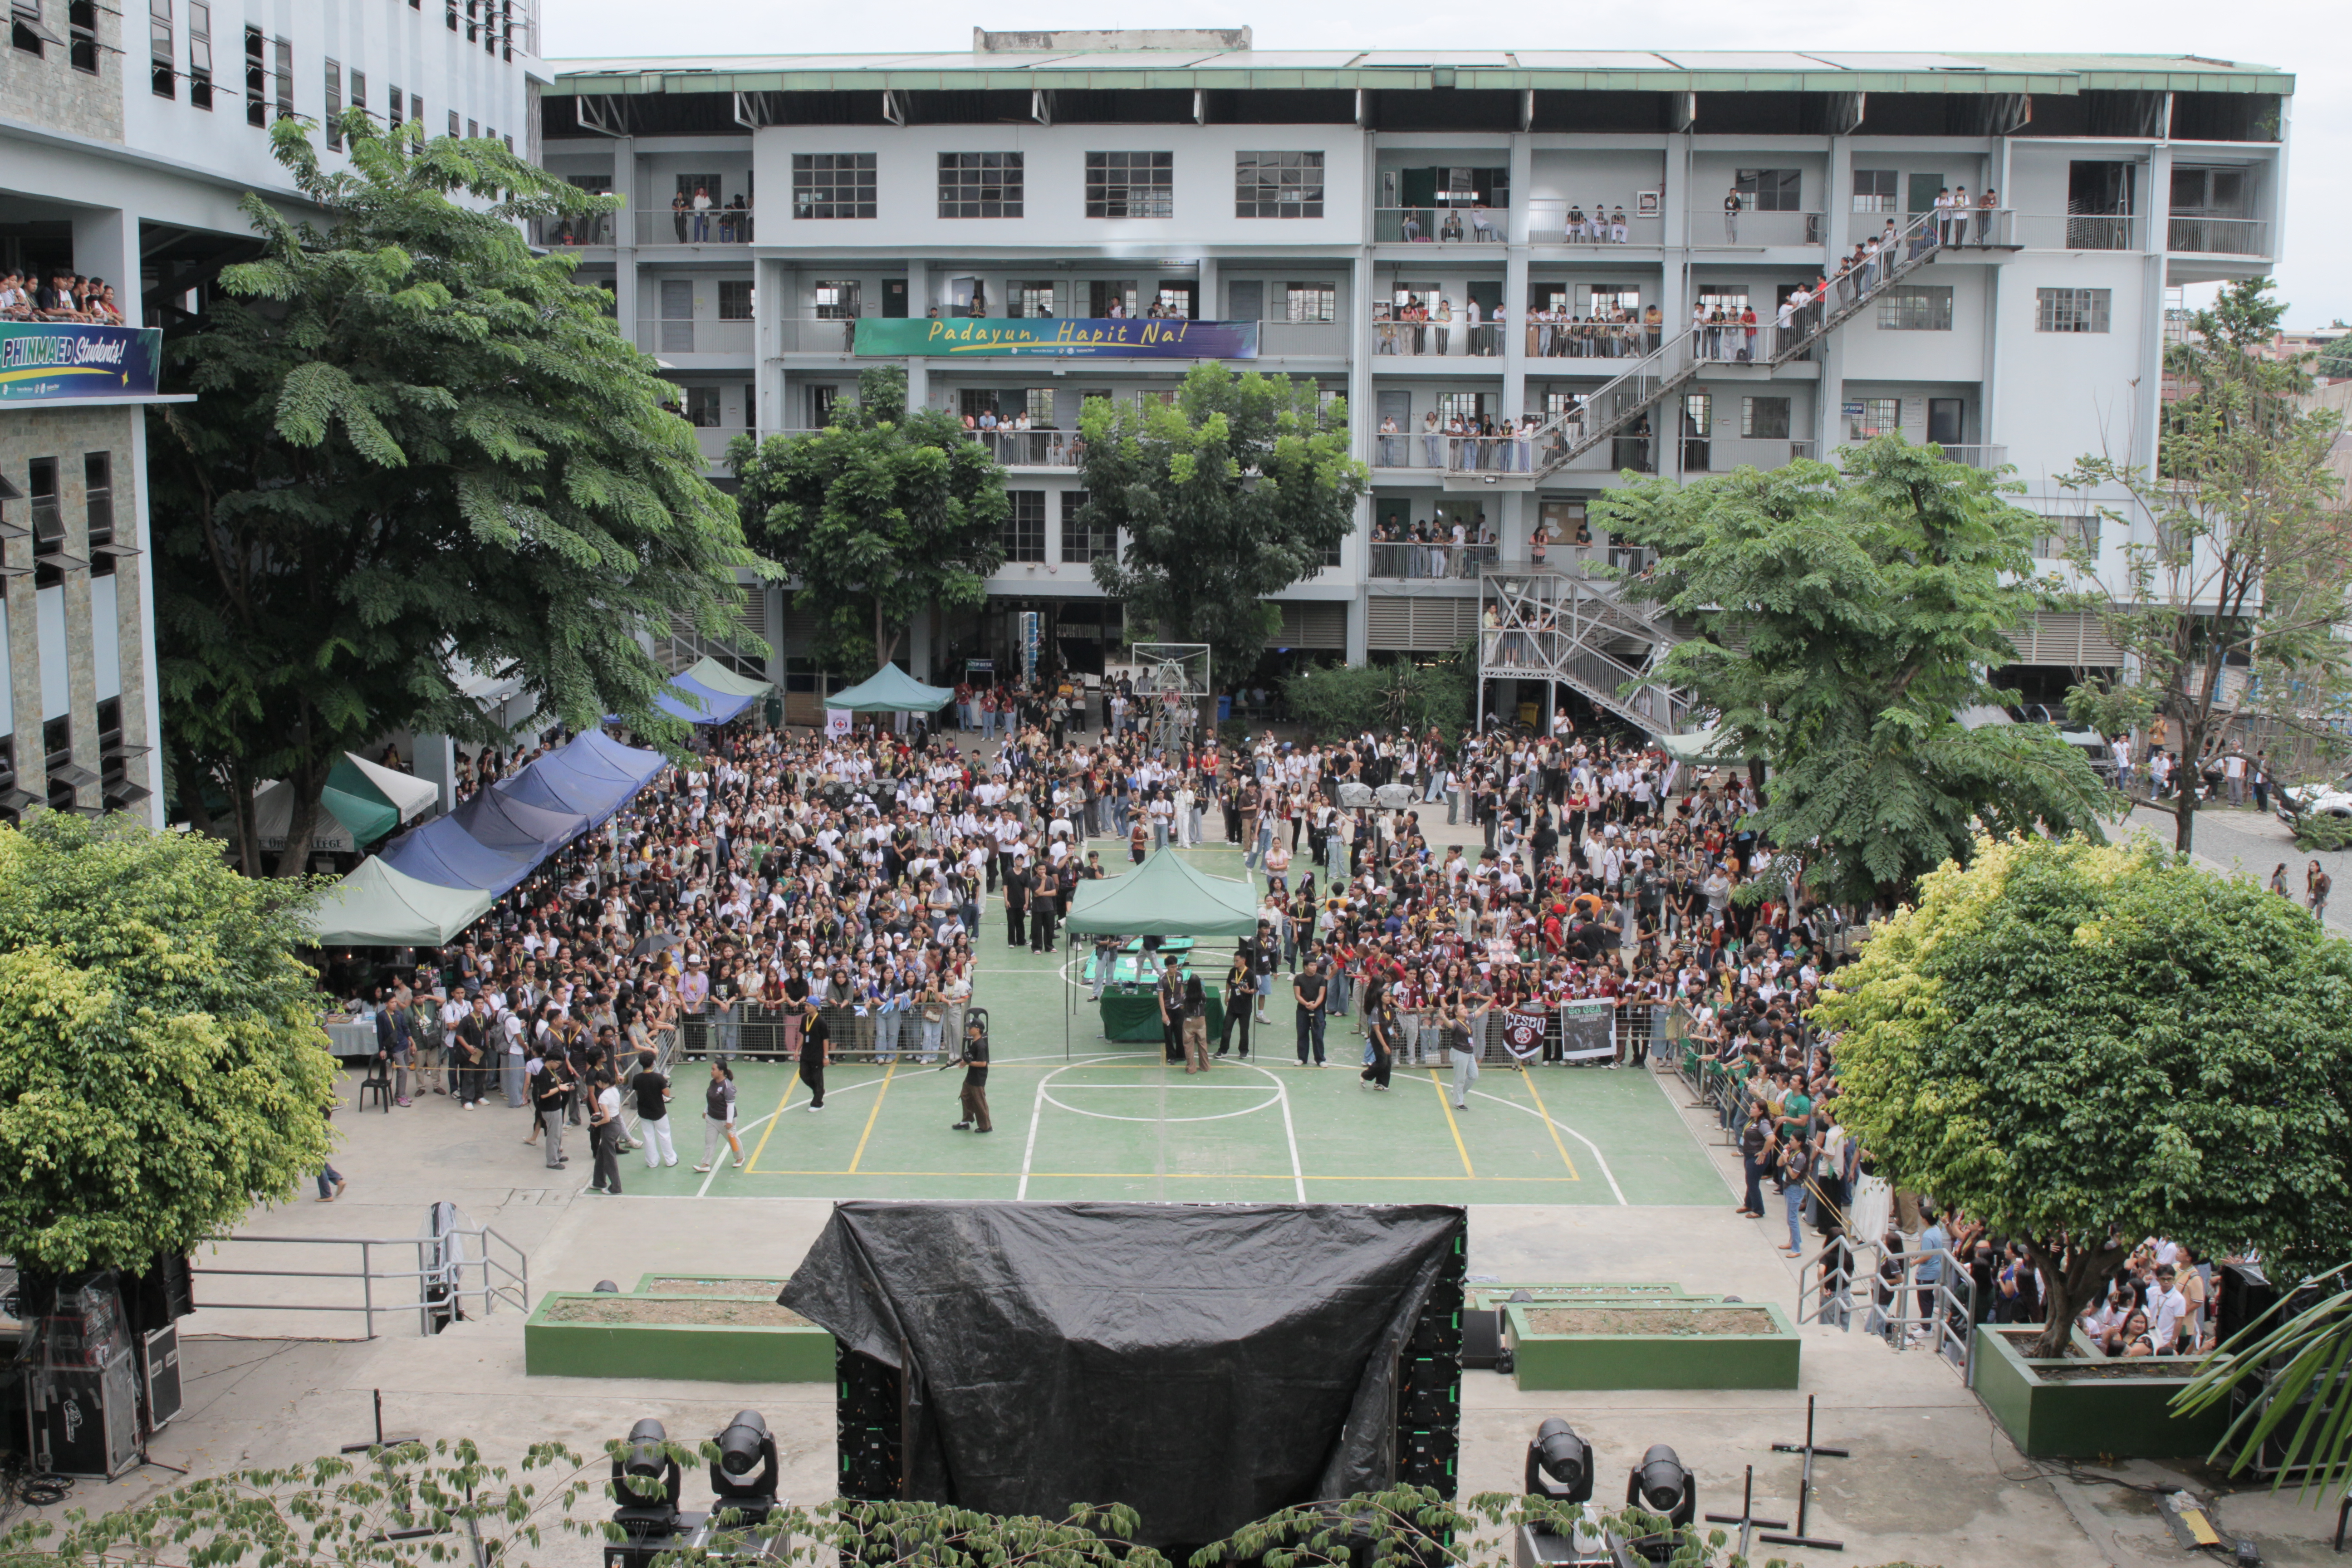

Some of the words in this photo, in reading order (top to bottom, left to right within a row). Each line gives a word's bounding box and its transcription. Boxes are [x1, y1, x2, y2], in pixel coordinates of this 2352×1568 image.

[928, 322, 1039, 345] Padayun,
[1057, 322, 1128, 346] Hapit
[1141, 322, 1187, 345] Na!
[2, 337, 74, 368] PHINMAED
[74, 337, 126, 365] Students!
[1505, 1013, 1546, 1036] CESBO
